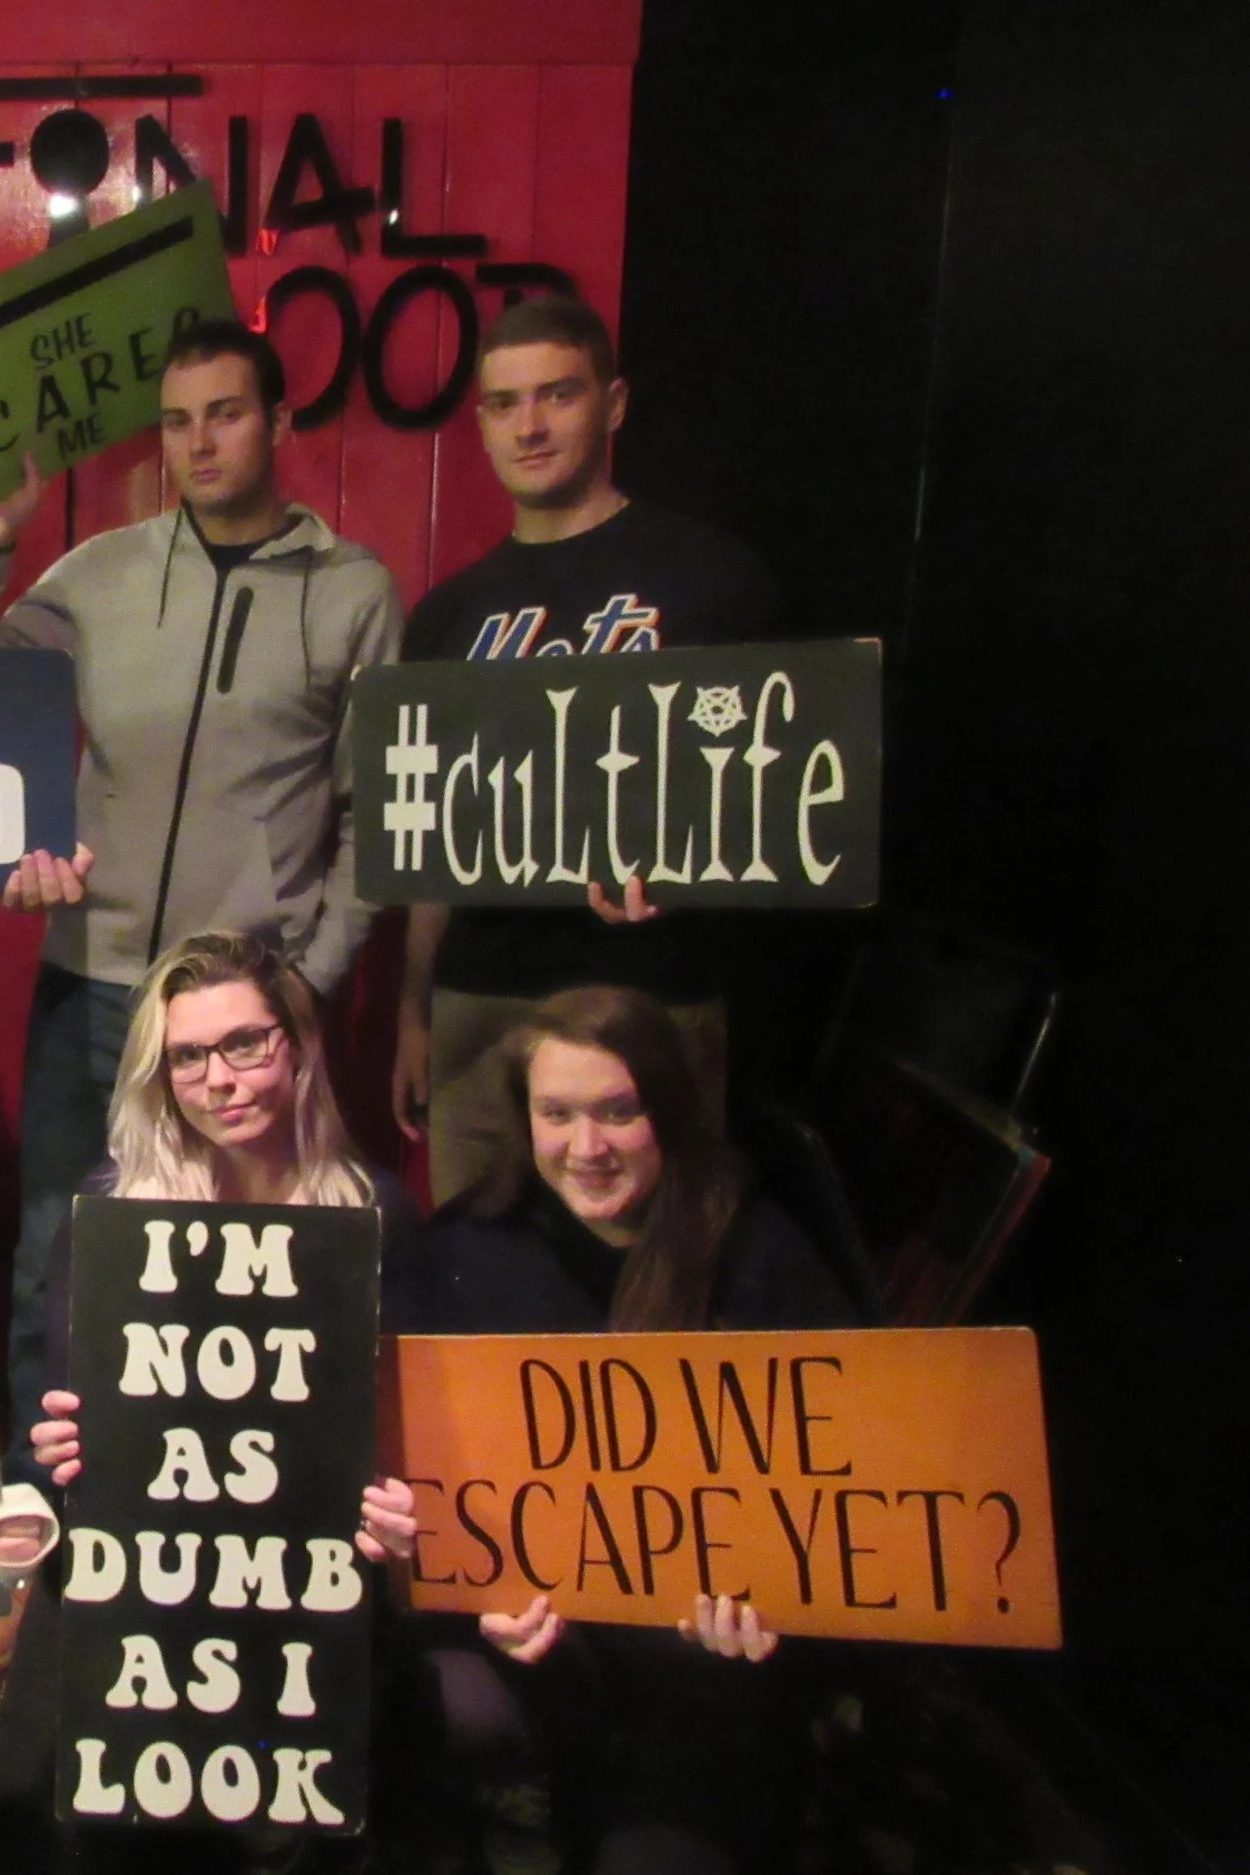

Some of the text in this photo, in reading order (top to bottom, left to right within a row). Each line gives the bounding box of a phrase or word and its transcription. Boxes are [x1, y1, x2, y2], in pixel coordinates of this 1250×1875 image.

[29, 311, 95, 370] SHE
[56, 412, 107, 461] ME
[138, 1220, 299, 1298] I'M
[119, 1322, 317, 1402] NOT
[519, 1355, 853, 1477] DID WE
[147, 1427, 280, 1504] AS
[63, 1527, 364, 1613] DUMB
[405, 1478, 1021, 1614] ESCAPE YET?
[105, 1634, 317, 1717] AS I
[72, 1738, 346, 1826] LOOK
